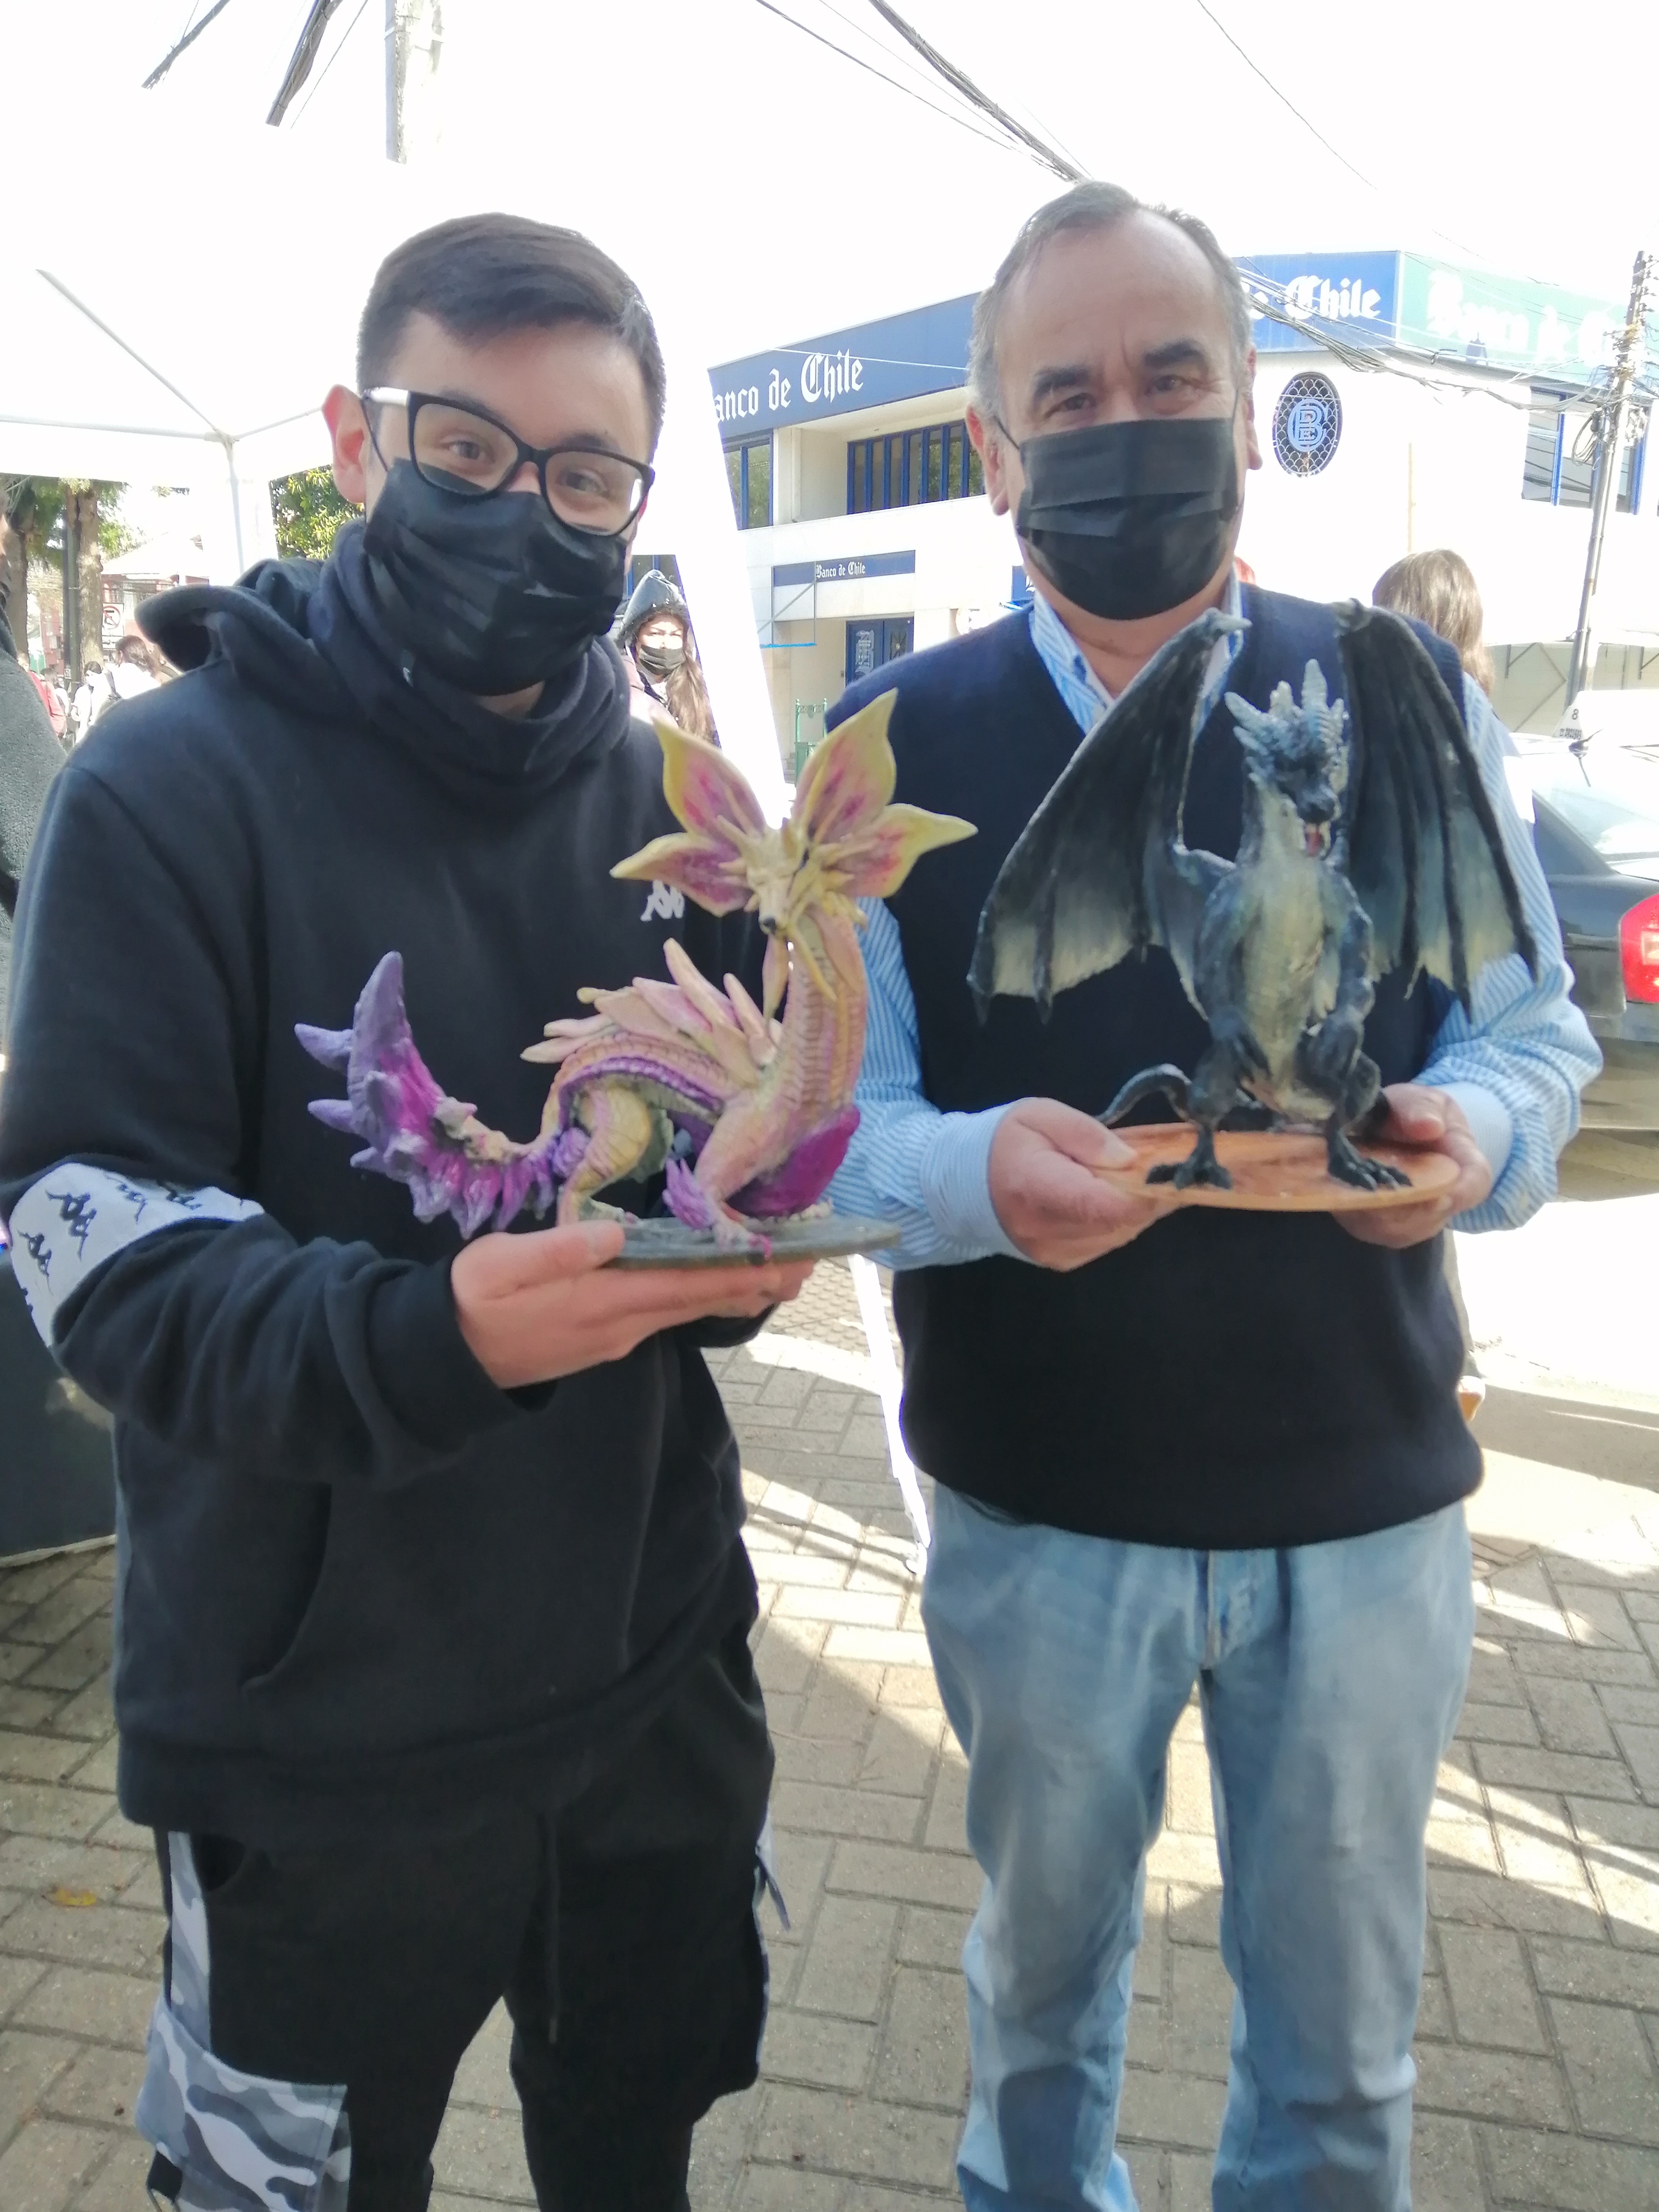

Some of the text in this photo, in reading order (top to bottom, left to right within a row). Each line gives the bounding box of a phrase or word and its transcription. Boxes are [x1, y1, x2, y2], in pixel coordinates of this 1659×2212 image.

[1285, 275, 1381, 319] Chile
[714, 348, 864, 422] anco de Chile
[816, 561, 866, 578] Banco de Chile
[1572, 709, 1579, 720] 8
